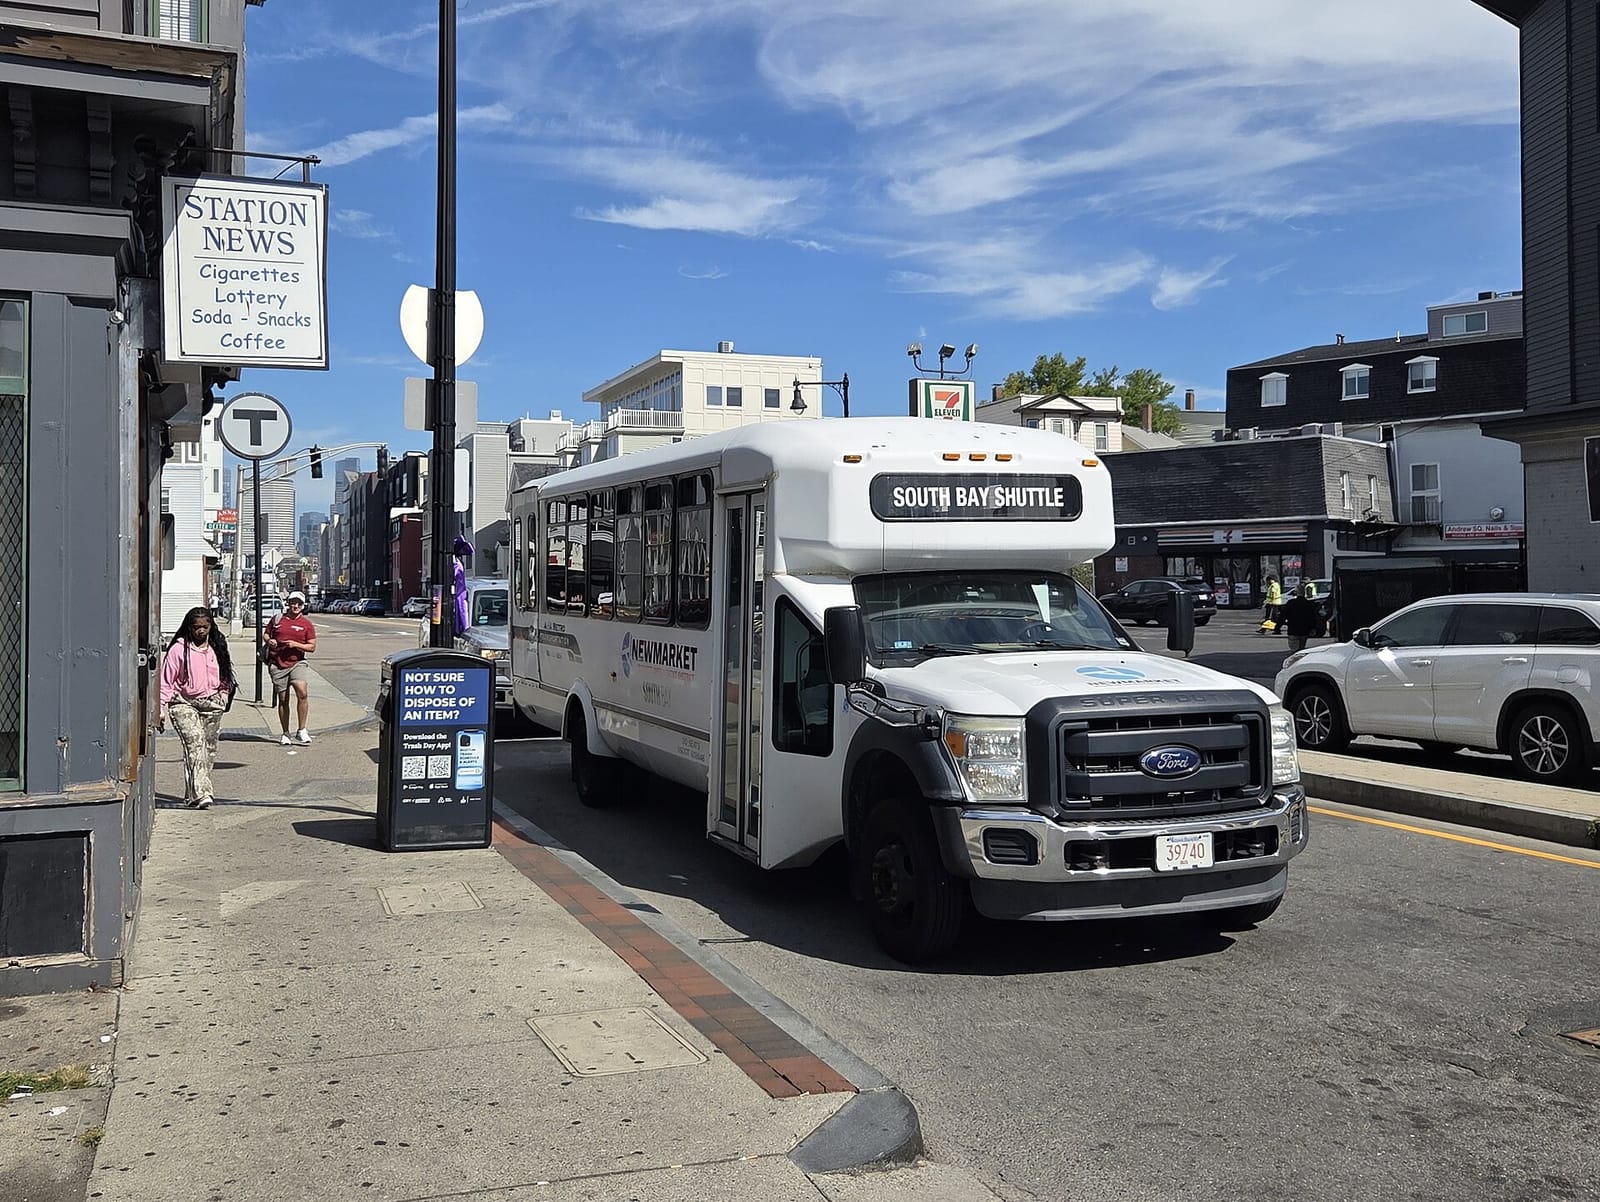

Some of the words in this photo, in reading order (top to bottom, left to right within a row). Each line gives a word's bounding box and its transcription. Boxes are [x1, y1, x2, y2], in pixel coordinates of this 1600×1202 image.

[184, 194, 308, 227] STATION
[202, 226, 295, 256] NEWS
[199, 263, 300, 284] Cigarettes
[215, 287, 287, 309] Lottery
[191, 309, 232, 325] Soda
[257, 311, 311, 328] Snacks
[220, 332, 286, 350] Coffee
[232, 408, 278, 446] T
[893, 486, 950, 508] SOUTH
[956, 486, 991, 507] BAY
[994, 486, 1064, 508] SHUTTLE
[1447, 525, 1471, 533] Andrew
[632, 638, 697, 672] NEWMARKET
[405, 672, 431, 683] NOT
[433, 672, 465, 682] SURE
[405, 685, 437, 695] HOW
[438, 685, 456, 695] TO
[404, 697, 457, 708] DISPOSE
[458, 697, 476, 707] OF
[1079, 695, 1165, 708] SUPER
[404, 710, 422, 721] AN
[425, 710, 460, 720] ITEM?
[403, 742, 422, 750] Trash
[423, 742, 436, 751] Day
[1157, 752, 1189, 769] Ford
[1166, 842, 1205, 862] 39740
